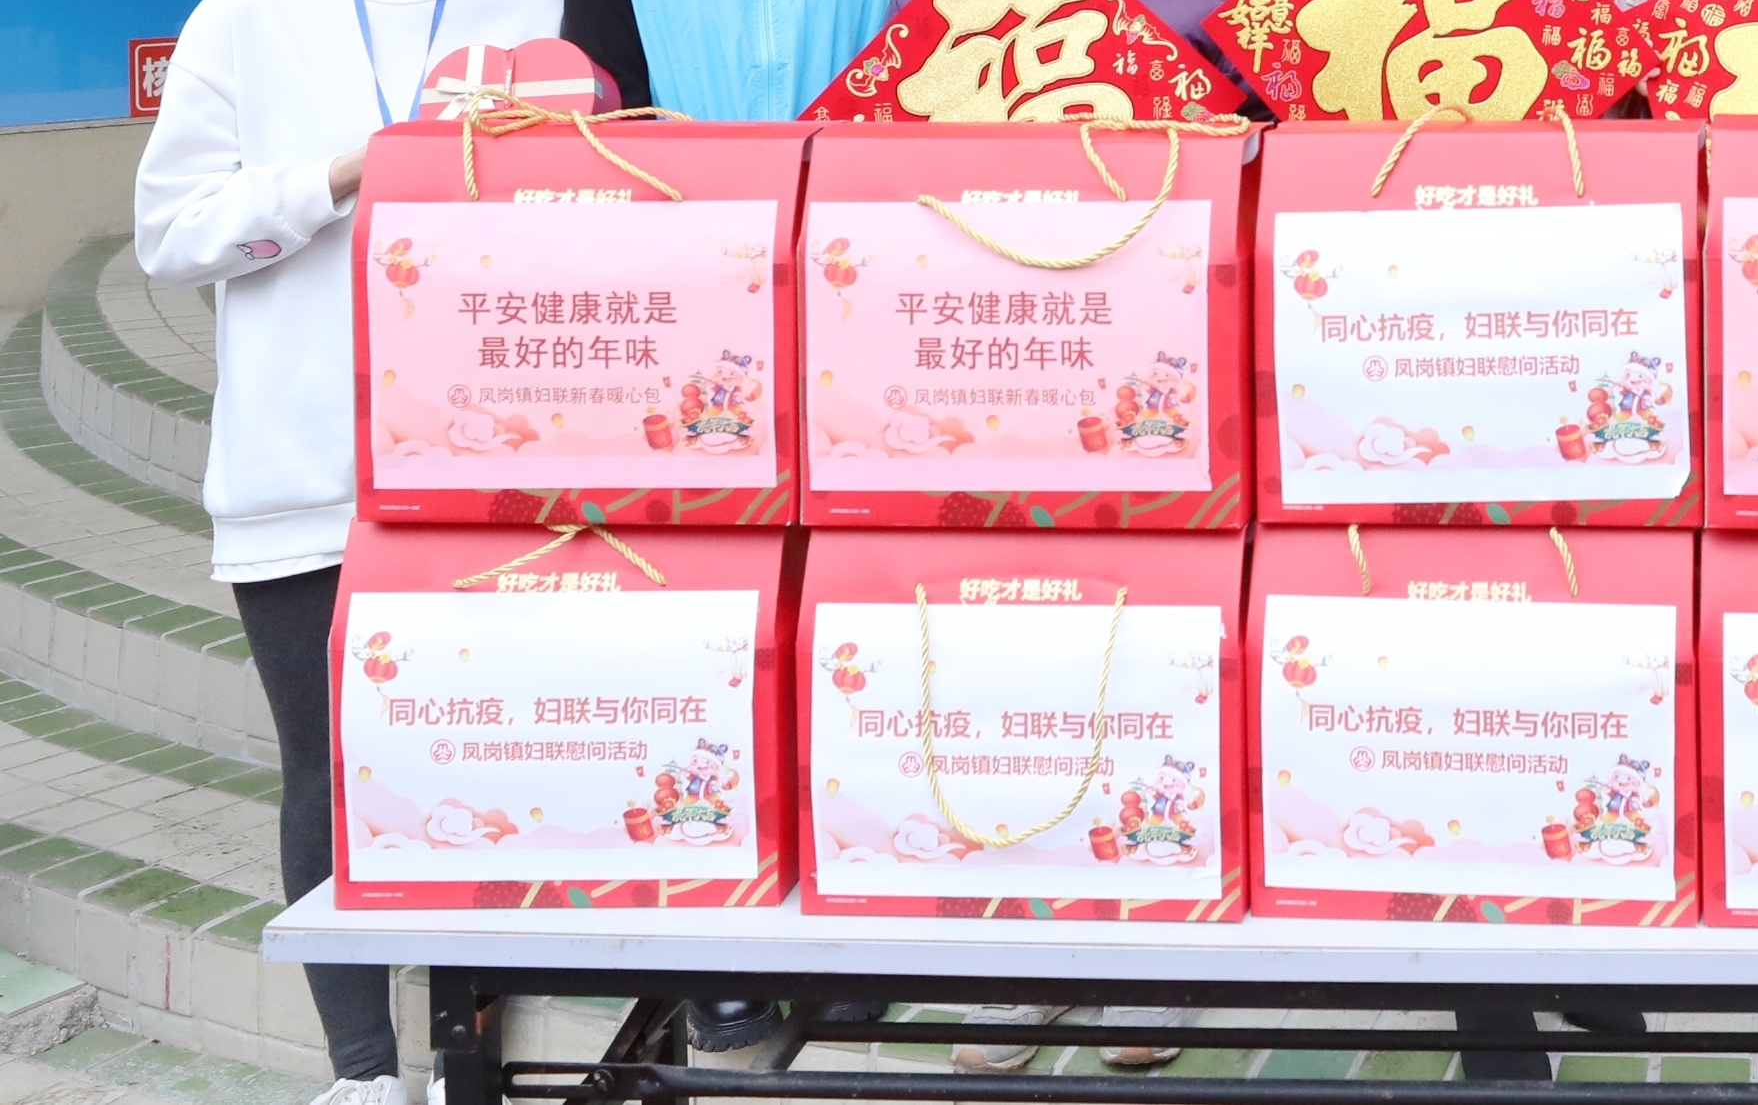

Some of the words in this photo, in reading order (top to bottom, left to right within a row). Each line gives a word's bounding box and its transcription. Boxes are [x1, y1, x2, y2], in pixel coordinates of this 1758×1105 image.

[1658, 17, 1710, 77] 福
[1168, 63, 1211, 101] 福
[1415, 184, 1539, 206] 好吃才是好礼
[457, 290, 679, 327] 平安健康就是
[895, 290, 1114, 327] 平安健康就是
[1320, 309, 1640, 345] 同心抗疫，妇联与你同在
[478, 334, 660, 372] 最好的年味
[914, 336, 1094, 372] 最好的年味
[1394, 355, 1581, 380] 凤岗镇妇联慰问活动
[478, 386, 662, 407] 凤岗镇妇联新春暖心包
[915, 387, 1096, 408] 凤岗镇妇联新春暖心包
[960, 577, 1083, 603] 好吃才是好礼
[387, 695, 708, 728] 同心抗疫，妇联与你同在
[857, 709, 1174, 742] 同心抗疫，妇联与你同在
[1306, 704, 1629, 742] 同心抗疫，妇联与你同在
[461, 738, 648, 764] 凤岗镇妇联慰问活动
[931, 752, 1115, 778] 凤岗镇妇联慰问活动
[1380, 749, 1569, 777] 凤岗镇妇联慰问活动
